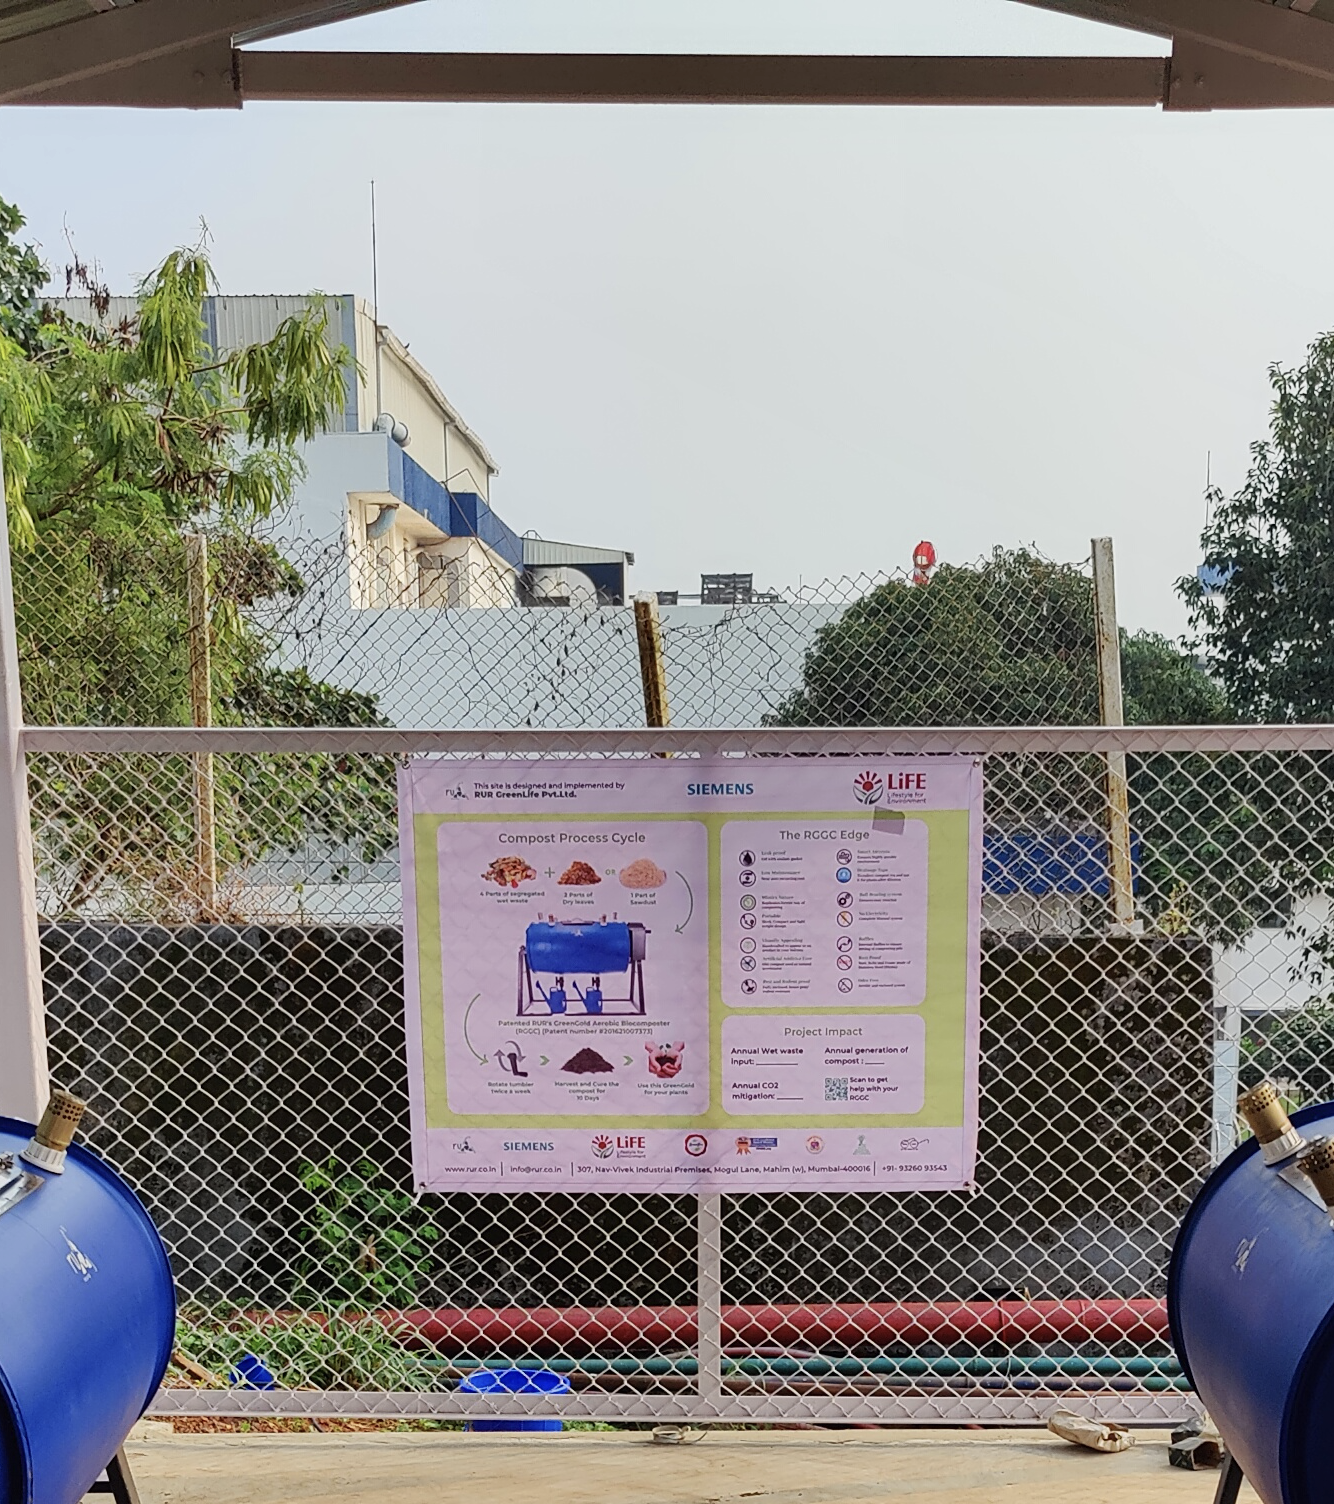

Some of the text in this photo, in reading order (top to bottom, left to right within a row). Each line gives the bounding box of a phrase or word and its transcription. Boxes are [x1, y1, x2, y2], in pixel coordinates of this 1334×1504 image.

[887, 772, 927, 790] LiFE
[473, 781, 626, 792] This site is designed and implemented by
[687, 783, 754, 796] SIEMENS
[474, 790, 578, 799] RUR GreenLife Pvt.Ltd.
[887, 792, 913, 800] Lifestyle
[498, 832, 646, 845] Compost Process Cycle
[779, 829, 870, 842] The RGGC Edge
[605, 868, 616, 876] OR
[510, 891, 545, 899] segregated
[621, 1020, 670, 1028] Biocomposter
[542, 1028, 568, 1036] (Patent
[784, 1027, 863, 1038] Project Impact
[730, 1047, 760, 1055] Annual
[761, 1047, 778, 1055] Wet
[824, 1046, 909, 1057] Annual generation of
[824, 1058, 860, 1066] compost
[876, 1076, 888, 1085] get
[732, 1082, 779, 1090] Annual CO2
[849, 1085, 865, 1093] help
[732, 1092, 775, 1101] mitigation:
[503, 1142, 555, 1151] SIEMENS
[617, 1136, 646, 1149] LiFE
[444, 1166, 497, 1174] www.rur.co.in
[577, 1164, 872, 1175] 307, Nav-Vivek Industrial Premises, Mogul Lane, Mahim (w), Mumbai-400016
[899, 1164, 922, 1172] 93260
[924, 1164, 948, 1172] 93543
